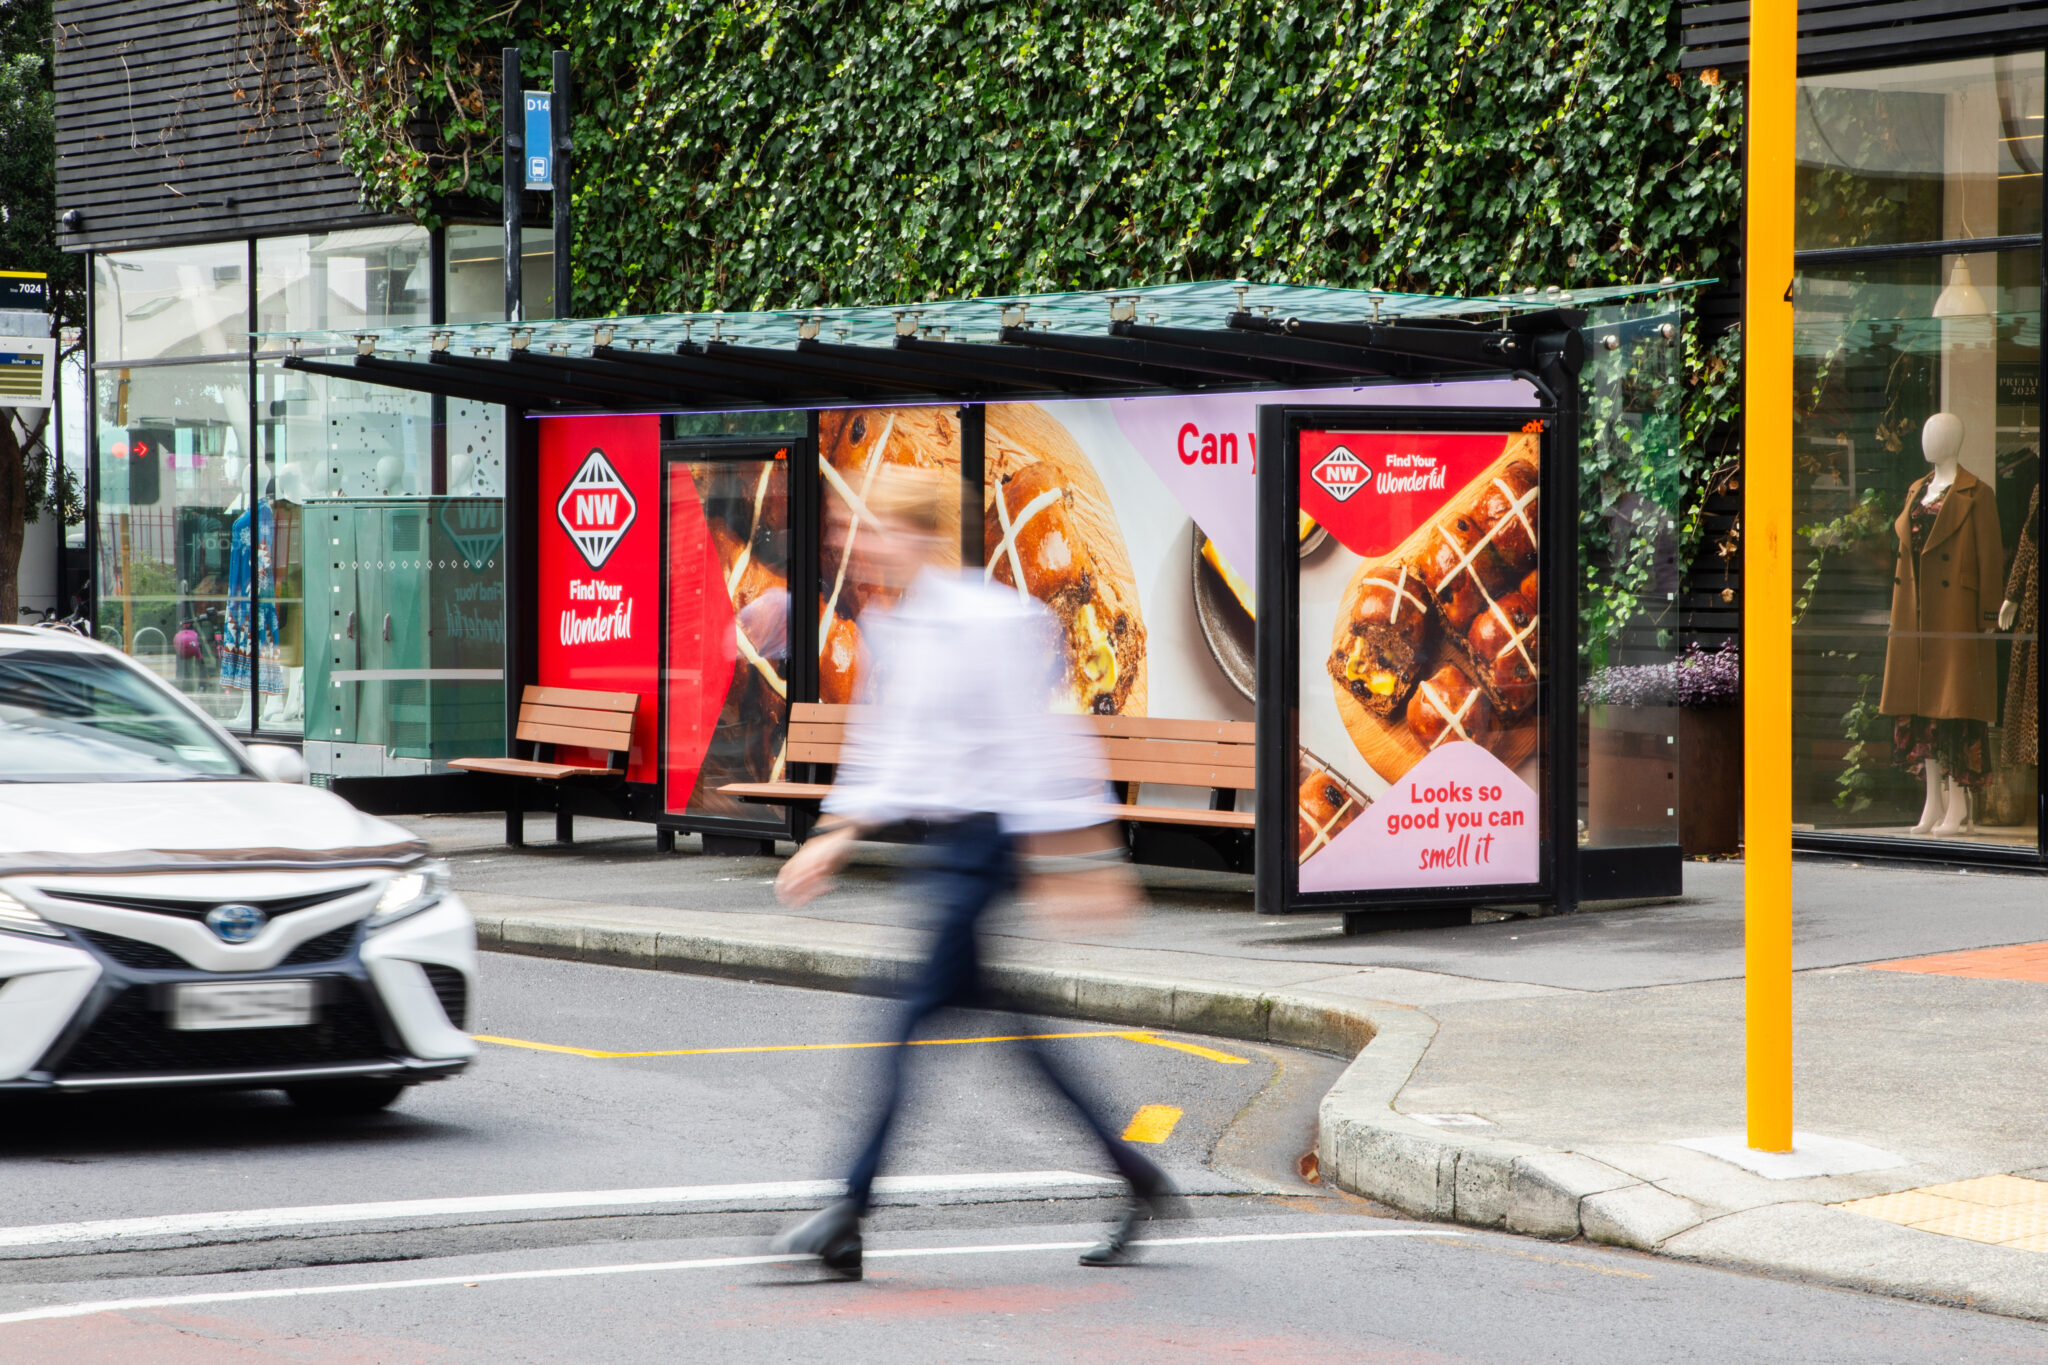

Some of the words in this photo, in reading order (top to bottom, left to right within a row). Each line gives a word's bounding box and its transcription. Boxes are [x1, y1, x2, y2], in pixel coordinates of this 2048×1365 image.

[527, 98, 550, 112] D14
[19, 283, 41, 294] 7024
[1177, 422, 1239, 466] Can
[1325, 466, 1359, 482] NW
[1386, 454, 1411, 468] Find
[1412, 455, 1437, 468] Your
[1376, 465, 1447, 494] Wonderful
[576, 493, 618, 526] NW
[569, 579, 595, 601] Find
[596, 580, 623, 601] Your
[560, 597, 633, 646] Wonderful
[1410, 781, 1473, 804] Looks
[1478, 785, 1503, 802] so
[1387, 807, 1439, 836] good
[1445, 811, 1482, 833] you
[1488, 809, 1524, 827] can
[1418, 833, 1471, 870] smell
[1475, 833, 1495, 865] it
